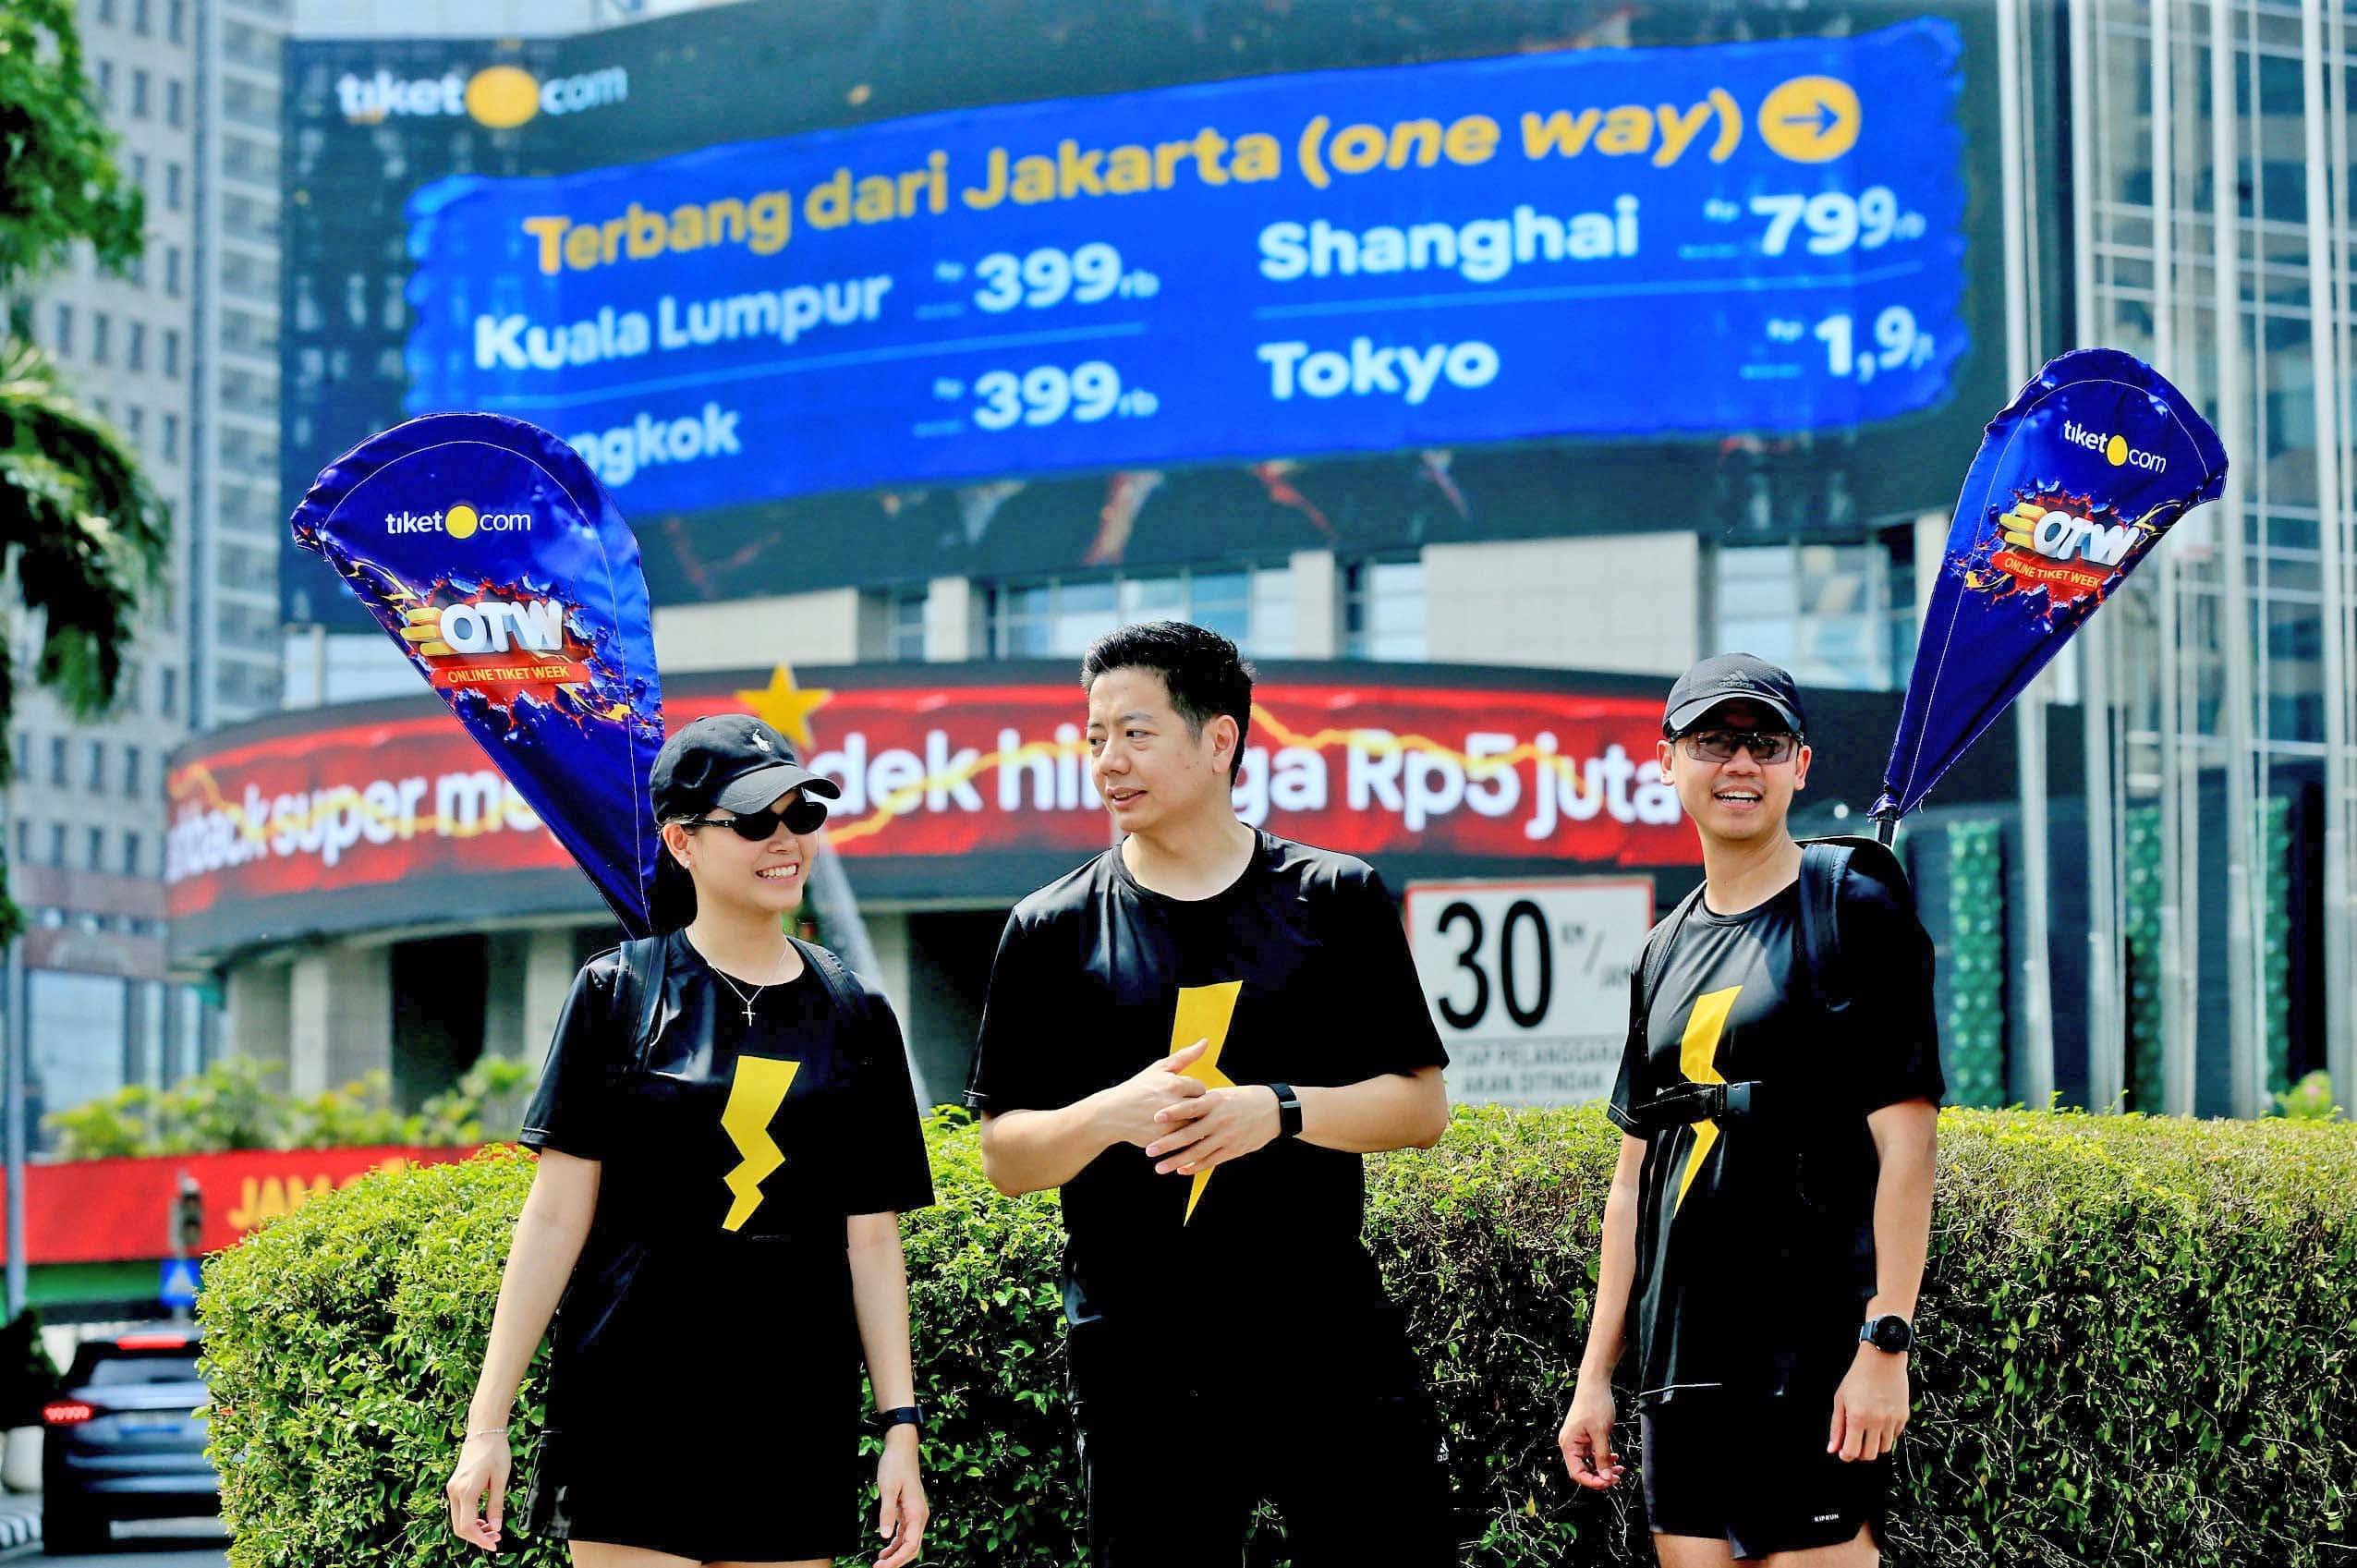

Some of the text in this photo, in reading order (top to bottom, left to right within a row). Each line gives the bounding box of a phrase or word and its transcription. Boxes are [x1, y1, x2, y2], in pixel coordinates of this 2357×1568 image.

[523, 88, 1743, 275] Terbang dari Jakarta (one way)
[1258, 193, 1641, 283] Shanghai
[474, 306, 650, 370] Kuala
[659, 274, 893, 345] Lumpur
[1257, 336, 1501, 405] Tokyo
[565, 402, 742, 487] ngkok
[2004, 557, 2101, 589] ONLINE TIKET WEEK
[2033, 510, 2140, 566] OTW
[440, 600, 565, 655] OTW
[447, 664, 570, 683] ONLINE TIKET WEEK
[271, 775, 427, 867] super
[1346, 728, 1522, 833] Rp5
[1525, 730, 1682, 841] juta
[1437, 899, 1552, 1030] 30
